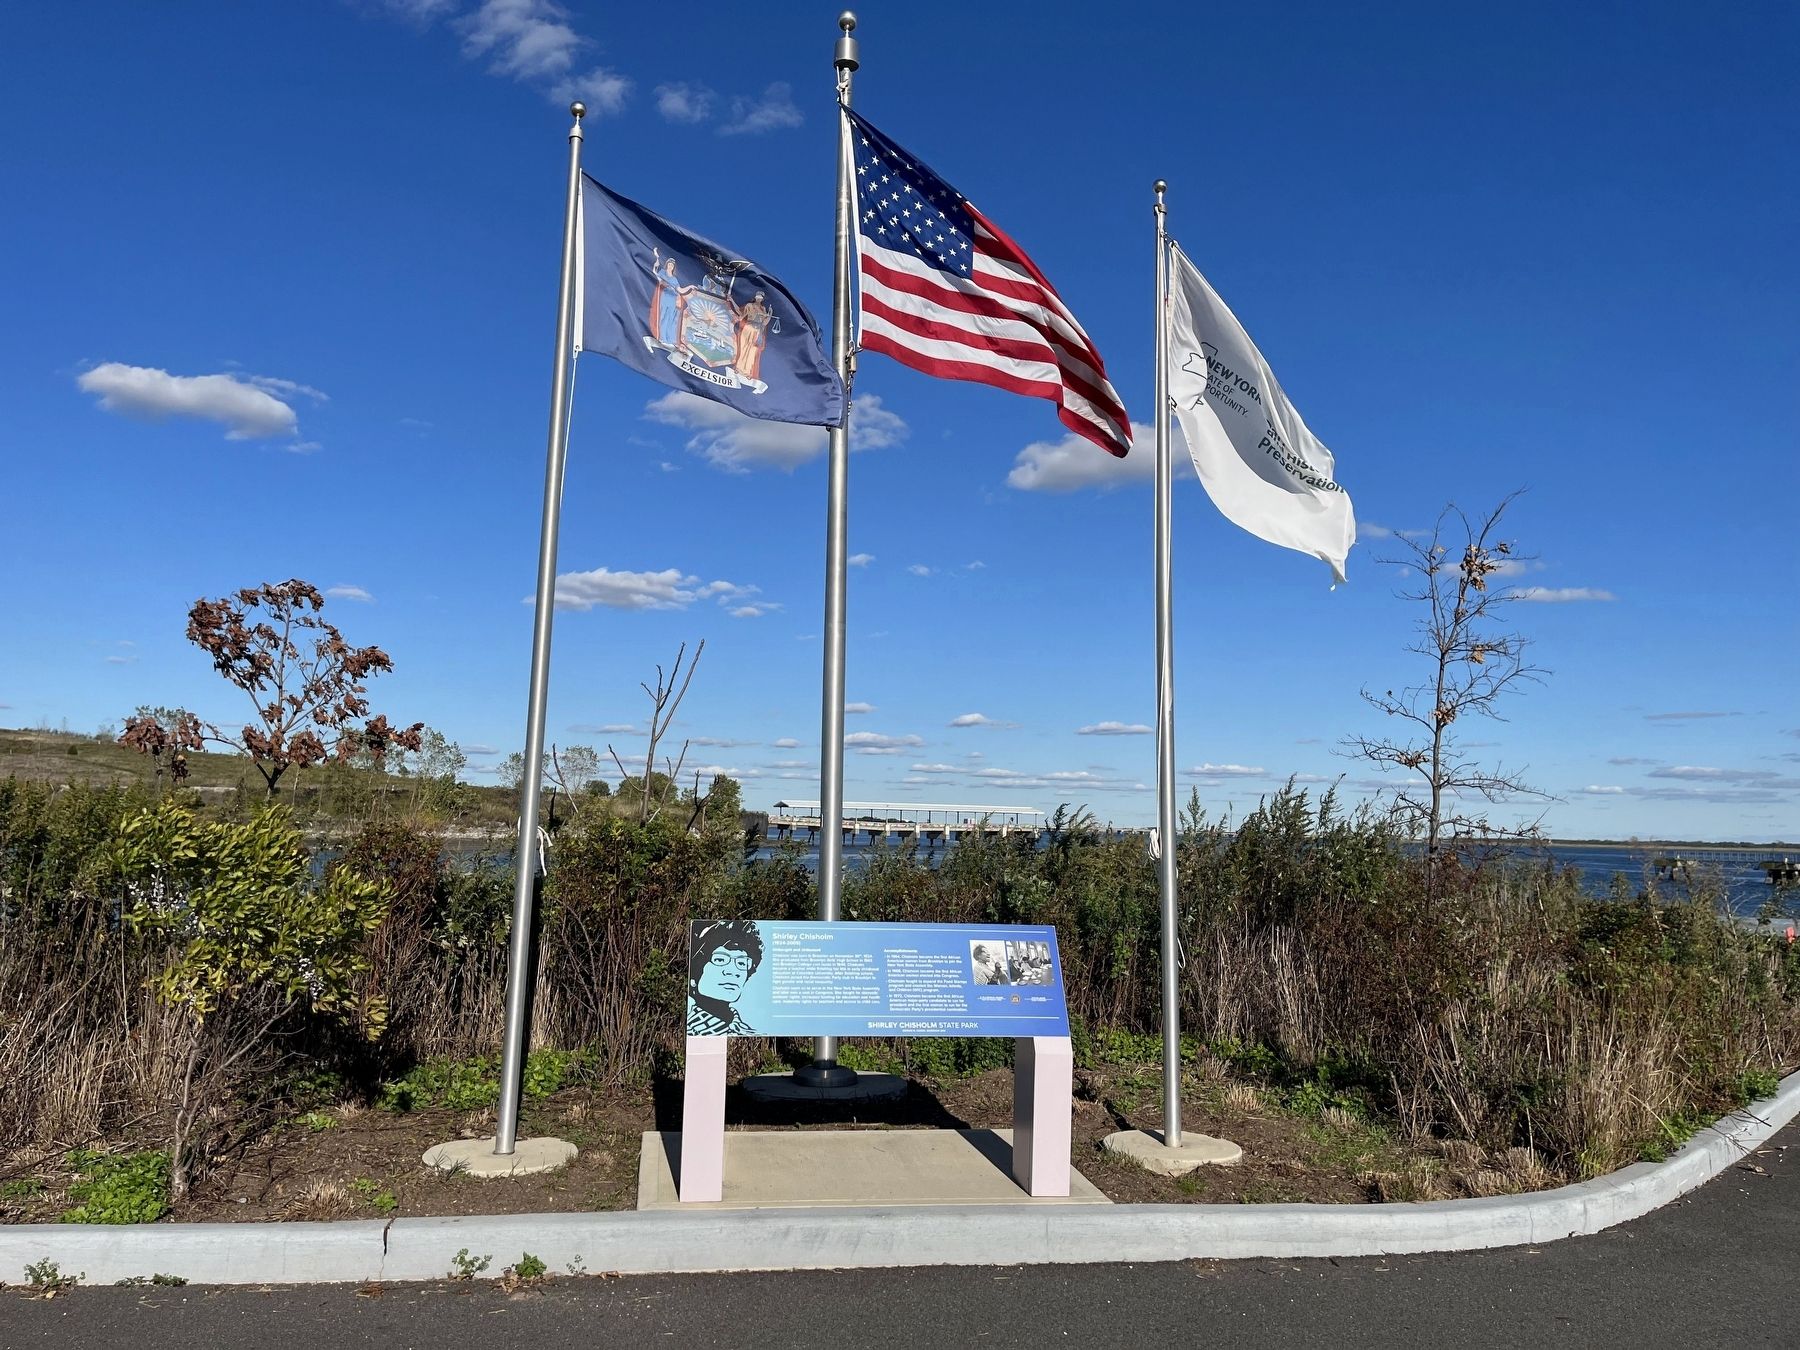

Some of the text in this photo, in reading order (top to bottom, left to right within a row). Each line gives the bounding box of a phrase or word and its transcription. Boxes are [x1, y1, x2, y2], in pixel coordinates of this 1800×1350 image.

[681, 361, 733, 386] EXCELSIOR
[1206, 355, 1234, 380] NEW
[1223, 384, 1235, 396] OF
[1258, 436, 1344, 494] Preservation
[772, 932, 798, 940] Shirley
